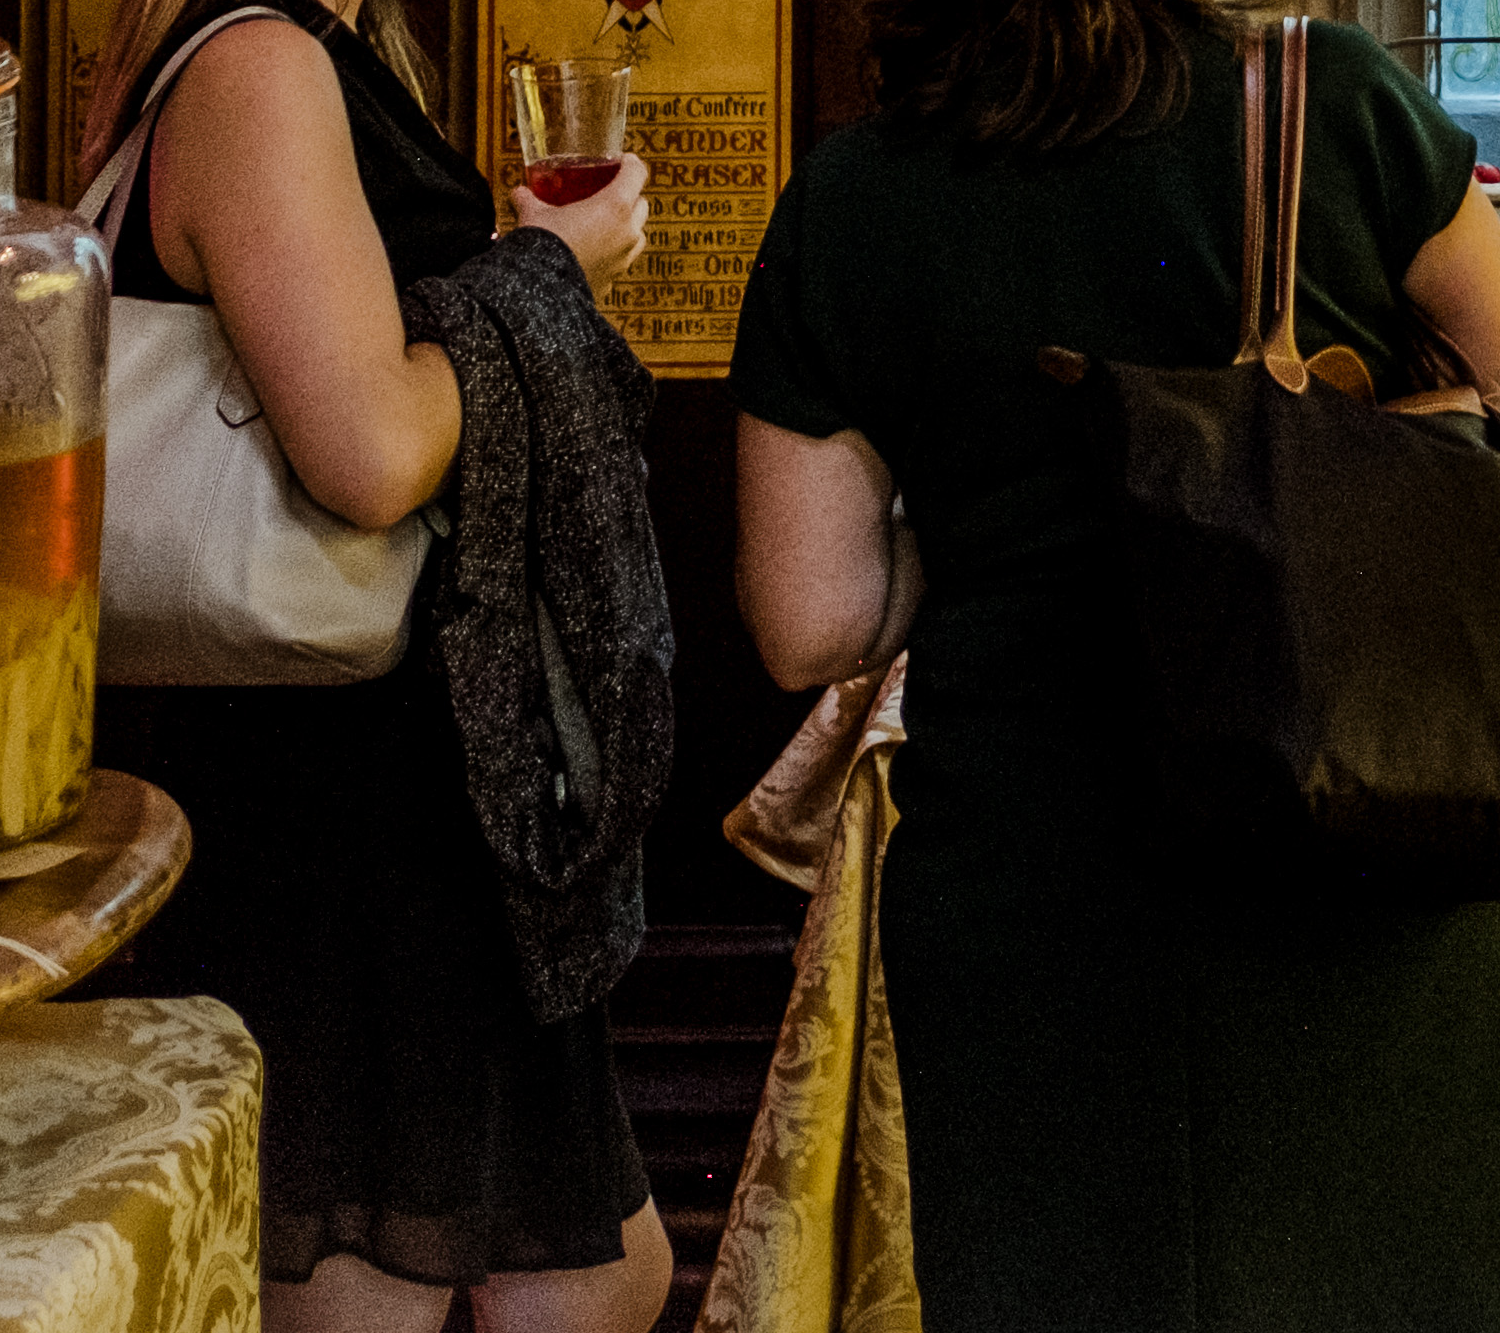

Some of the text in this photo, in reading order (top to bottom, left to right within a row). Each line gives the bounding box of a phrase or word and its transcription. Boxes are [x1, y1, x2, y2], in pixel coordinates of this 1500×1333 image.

[663, 97, 681, 117] of
[673, 197, 732, 216] Cross
[679, 227, 736, 249] years
[652, 316, 705, 339] years
